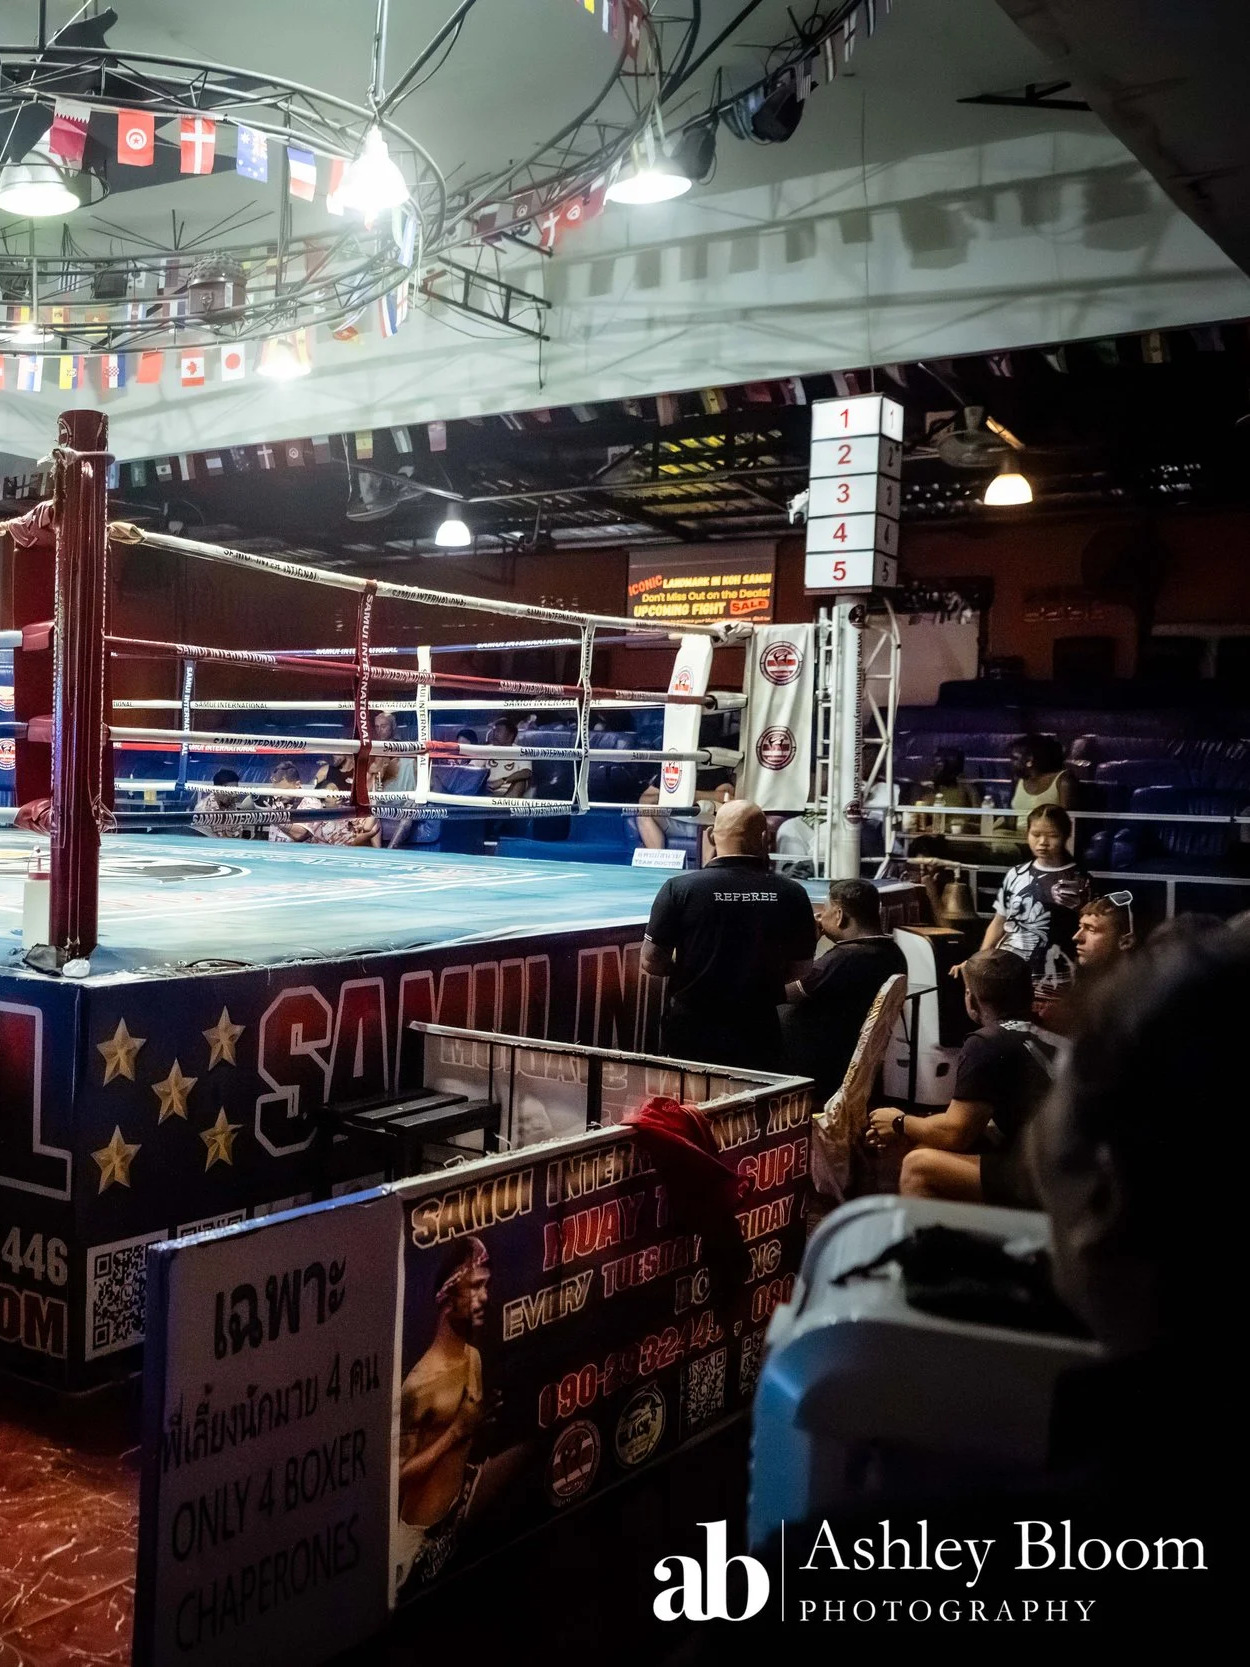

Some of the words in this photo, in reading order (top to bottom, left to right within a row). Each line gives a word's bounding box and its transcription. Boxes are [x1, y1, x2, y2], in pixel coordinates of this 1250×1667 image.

[840, 408, 849, 428] 1
[837, 444, 852, 465] 2
[836, 483, 850, 503] 3
[832, 522, 848, 543] 4
[662, 577, 710, 589] LANDMARK
[721, 575, 742, 586] KOH
[832, 561, 847, 581] 5
[628, 575, 663, 597] ICONIC
[642, 593, 666, 602] Don't
[667, 592, 687, 602] Miss
[688, 591, 705, 601] Out
[707, 592, 720, 600] on
[721, 590, 738, 599] the
[362, 594, 374, 642] SAMUI
[633, 603, 690, 617] UPCOMING
[691, 602, 727, 616] FIGHT
[732, 600, 767, 612] SALE
[177, 645, 207, 655] SAMUI
[208, 648, 278, 665] INTERNATIONAL
[184, 666, 193, 693] SAMUI
[359, 644, 371, 747] INTERNATIONAL
[181, 694, 191, 756] INTERNAAL
[418, 700, 427, 767] INTERNATAL
[192, 813, 223, 825] SAMUI
[224, 811, 292, 825] INTERNATIONAL
[371, 807, 396, 818] SAMUI
[397, 807, 449, 819] INTERNATIONAL
[411, 1168, 535, 1250] SAMUI
[542, 1191, 646, 1273] MUAY
[737, 1137, 809, 1198] SUPE
[503, 1269, 594, 1342] EVERY
[734, 1193, 795, 1243] RIDAY
[214, 1255, 347, 1360] เฉพาะ
[325, 1352, 342, 1404] 4
[349, 1353, 381, 1399] คน
[171, 1475, 252, 1562] ONLY
[258, 1468, 276, 1517] 4
[284, 1428, 367, 1512] BOXER
[175, 1512, 361, 1652] CHAPERONES
